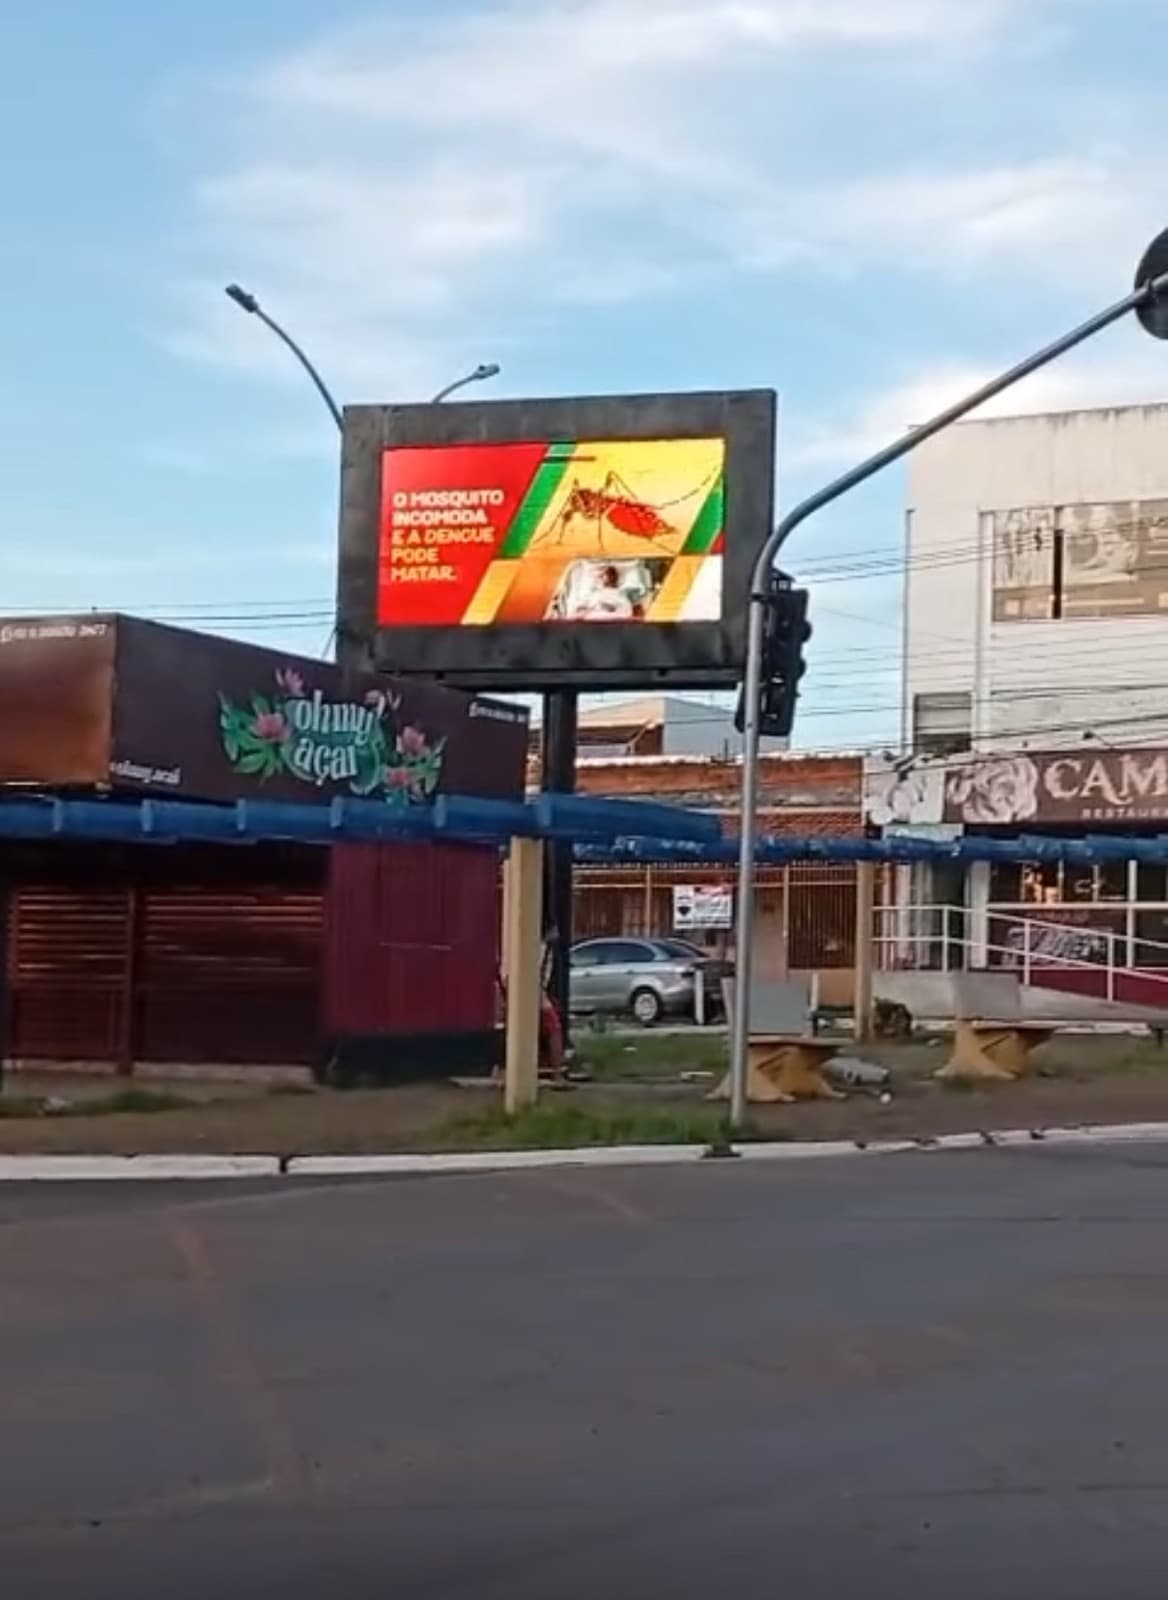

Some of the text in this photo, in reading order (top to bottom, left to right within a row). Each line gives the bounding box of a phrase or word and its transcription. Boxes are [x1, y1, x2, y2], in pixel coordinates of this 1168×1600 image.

[393, 490, 504, 508] O MOSQUITO
[393, 509, 488, 526] INCOMODA
[392, 527, 495, 545] E A DENGUE
[391, 548, 439, 563] PODE
